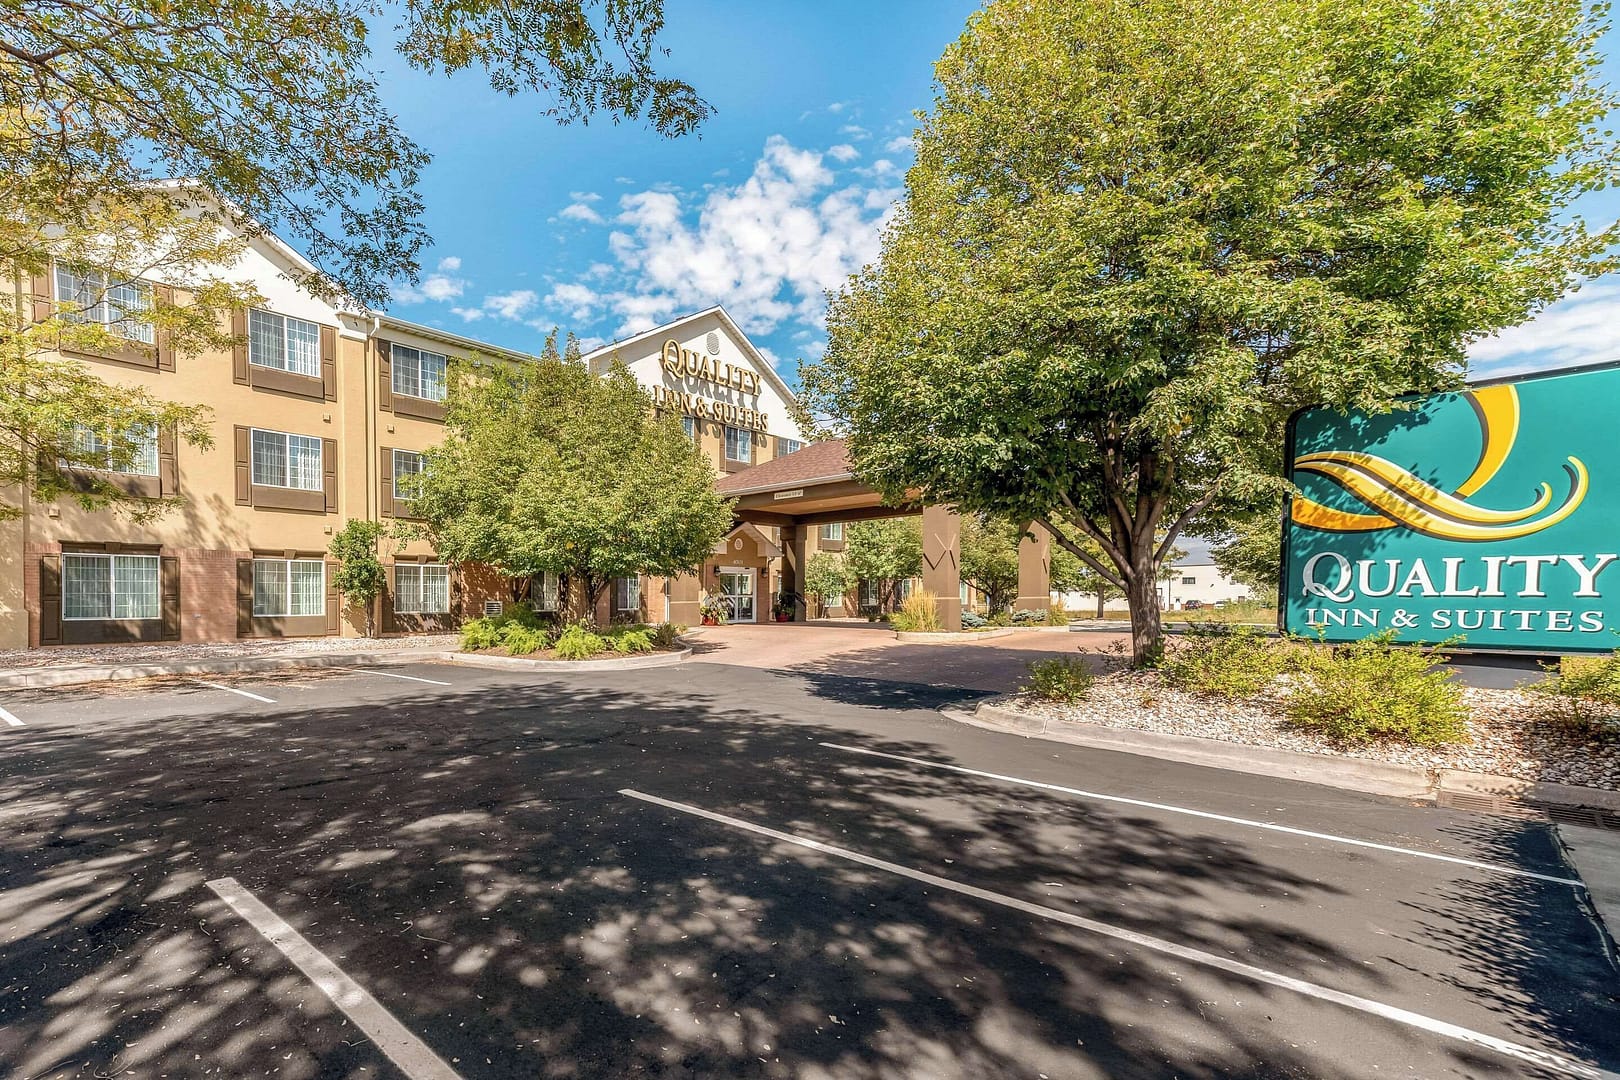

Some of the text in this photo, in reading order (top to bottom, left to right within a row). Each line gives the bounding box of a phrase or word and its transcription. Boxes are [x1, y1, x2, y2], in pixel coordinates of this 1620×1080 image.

[662, 339, 763, 396] QUALITY
[653, 385, 768, 432] INN & SUITES
[1302, 551, 1618, 602] QUALITY
[1305, 608, 1604, 632] INN & SUITES
